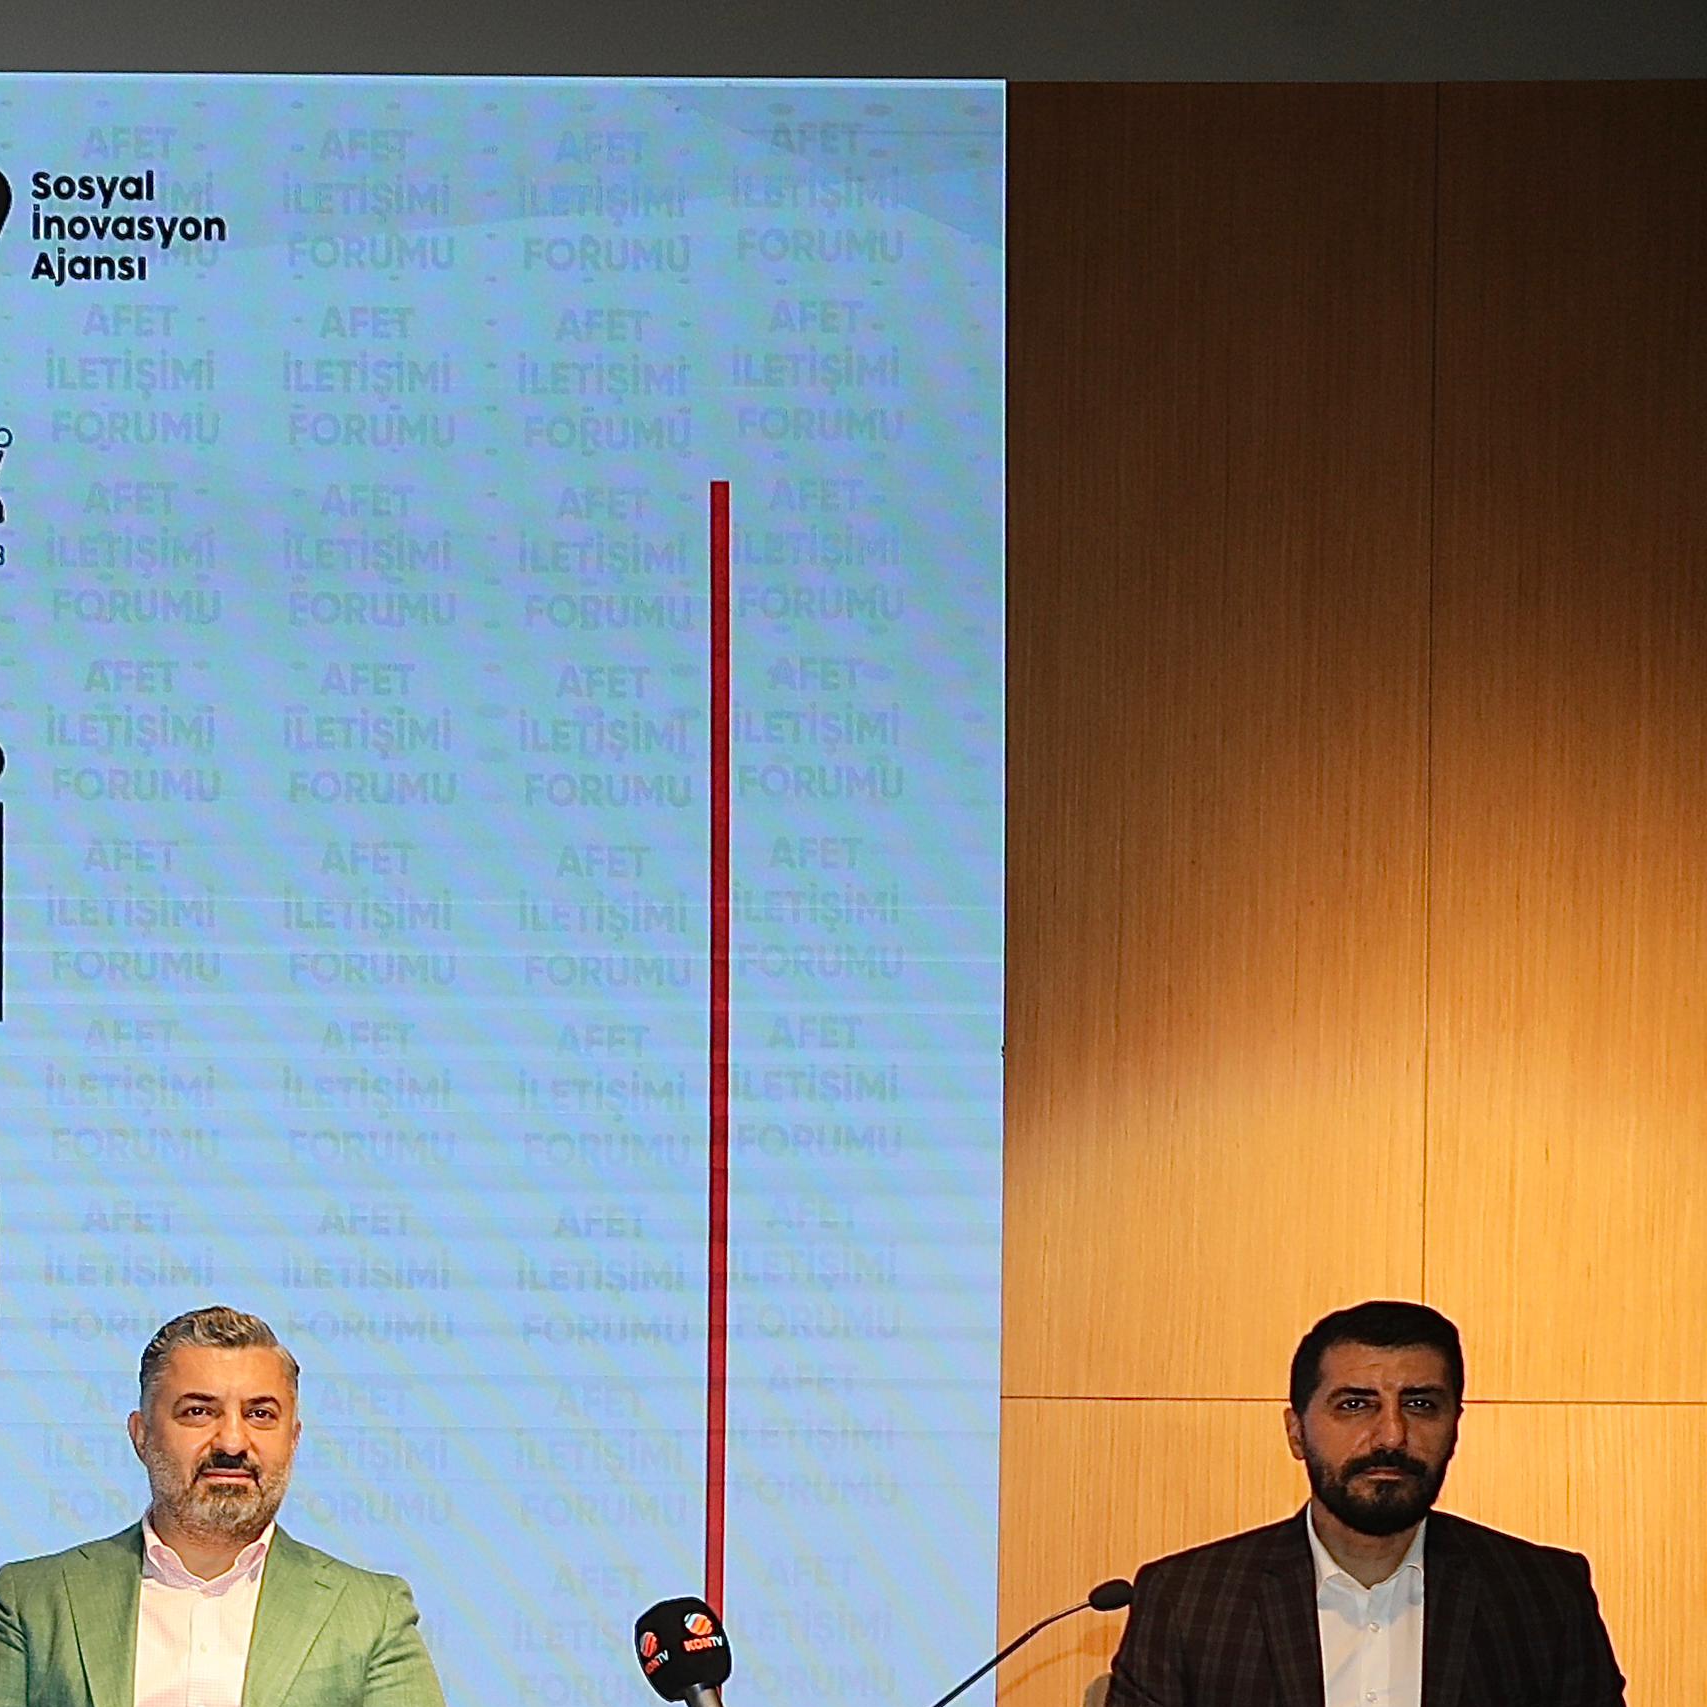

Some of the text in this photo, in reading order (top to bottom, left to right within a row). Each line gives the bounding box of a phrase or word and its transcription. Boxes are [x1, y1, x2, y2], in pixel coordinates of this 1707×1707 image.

[31, 170, 155, 209] Sosyal
[31, 203, 227, 249] İnovasyon
[30, 250, 148, 287] Ajansı
